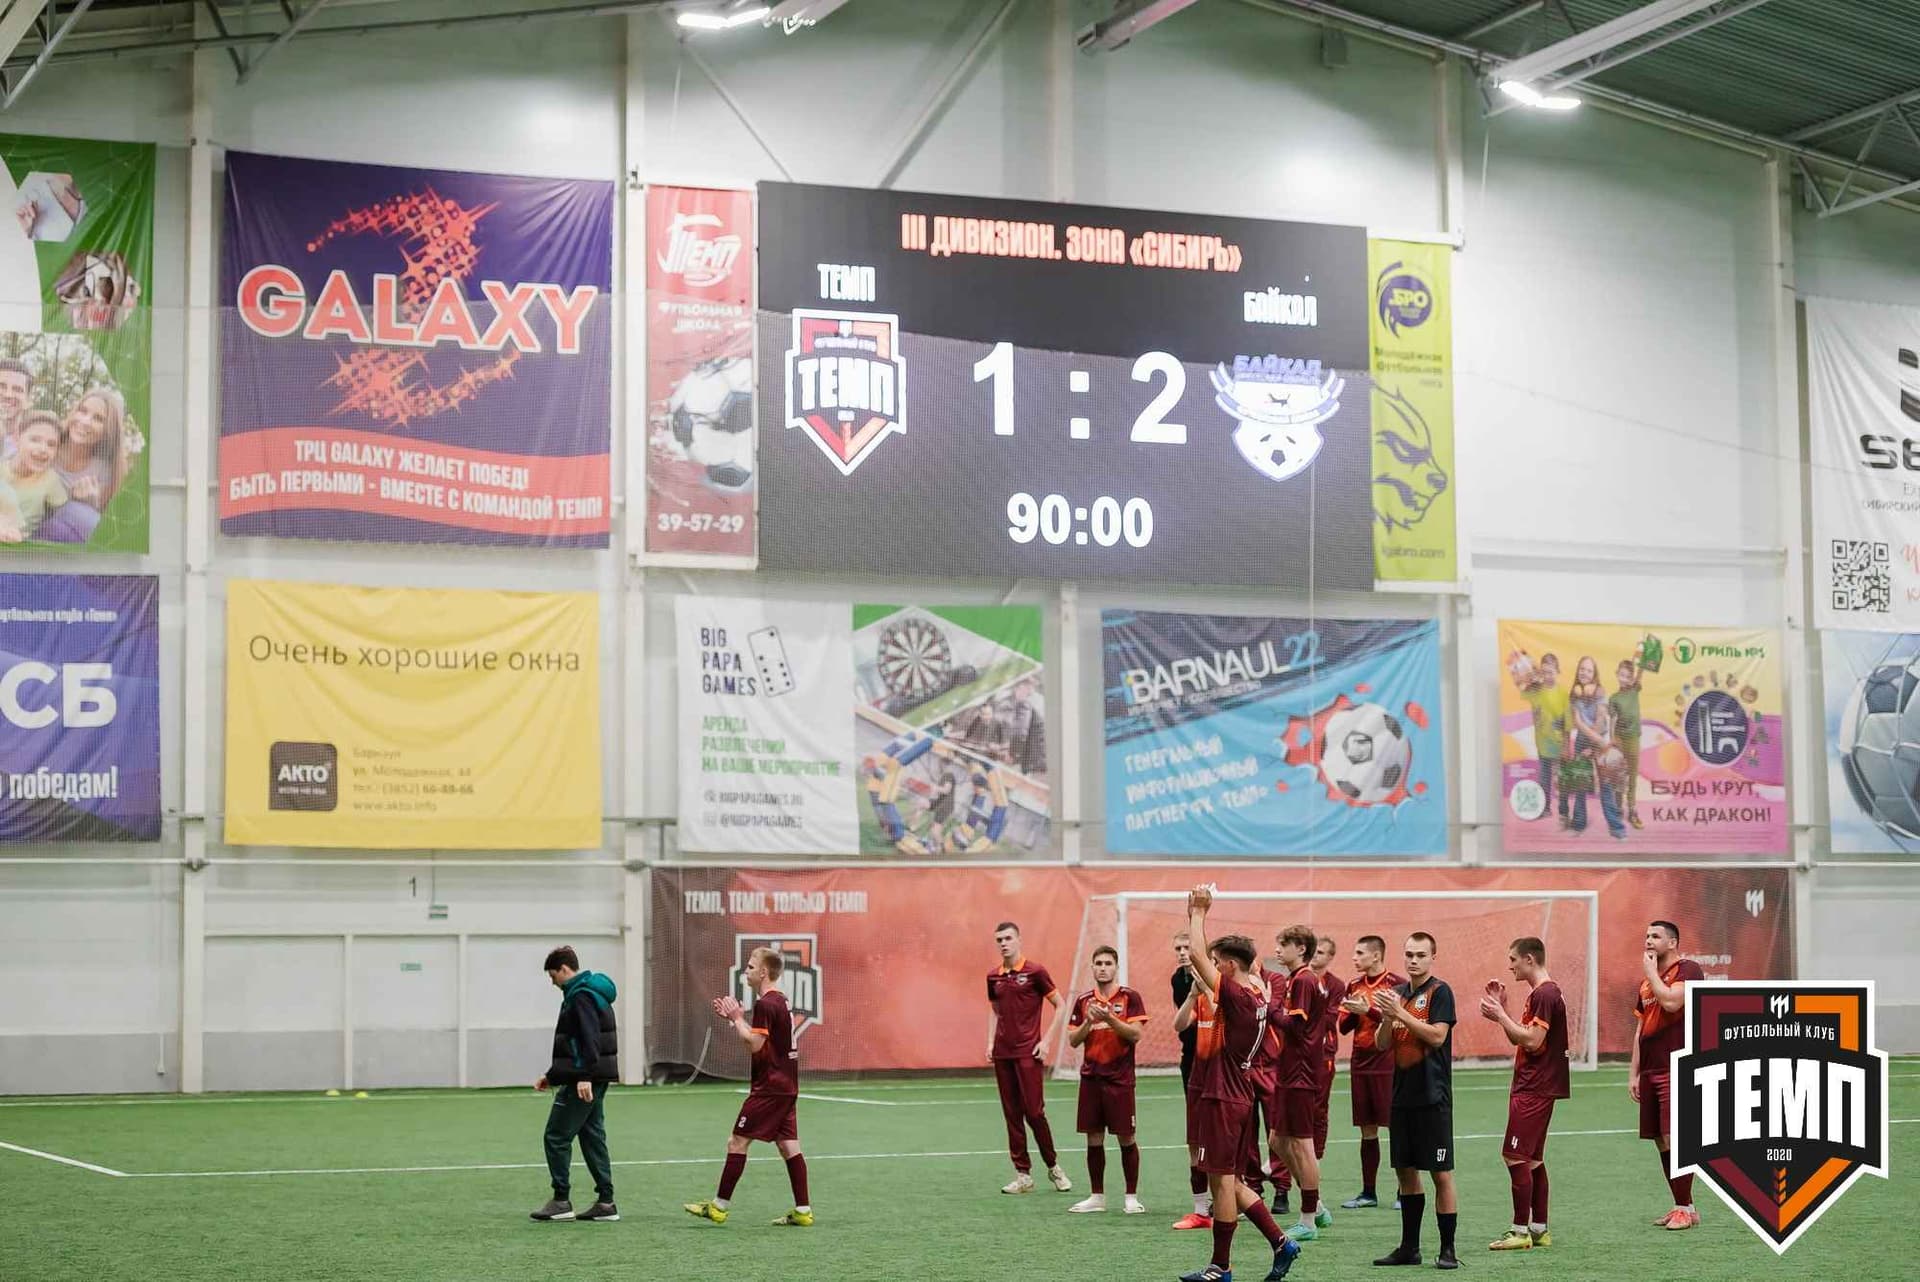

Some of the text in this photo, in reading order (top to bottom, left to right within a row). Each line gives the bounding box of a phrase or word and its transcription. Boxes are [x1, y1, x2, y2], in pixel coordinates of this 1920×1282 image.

[902, 213, 1242, 272] III ДИВИЗИОН. ЗОНА «СИБИРЬ»
[817, 263, 876, 302] ТЕМП
[237, 264, 598, 355] GALAXY
[798, 356, 894, 416] ТЕМП
[974, 342, 1014, 435] 1
[1130, 351, 1187, 444] 2
[294, 440, 529, 491] ТРЦ GALAXY ЖЕЛАЕТ ПОБЕД!
[230, 473, 276, 500] БЫТЬ
[281, 470, 364, 496] ПЕРВЫМИ
[380, 476, 443, 508] ВМЕСТЕ
[448, 486, 459, 510] С
[463, 490, 553, 521] КОМАНДОЙ
[658, 513, 744, 533] 39-57-29
[1007, 492, 1153, 548] 90:00
[249, 635, 580, 673] Очень хорошие окна
[701, 627, 727, 648] BIG
[1701, 646, 1742, 658] ГРИЛЬ
[702, 651, 743, 672] PAPA
[702, 674, 757, 696] GAMES
[9, 766, 118, 802] победам!
[1651, 781, 1708, 799] БУДЬ
[1653, 808, 1772, 826] КАК ДРАКОН!
[685, 890, 726, 916] ТЕМП,
[729, 890, 770, 916] ТЕМП,
[773, 890, 826, 914] ТОЛЬКО
[1511, 1135, 1518, 1149] 4
